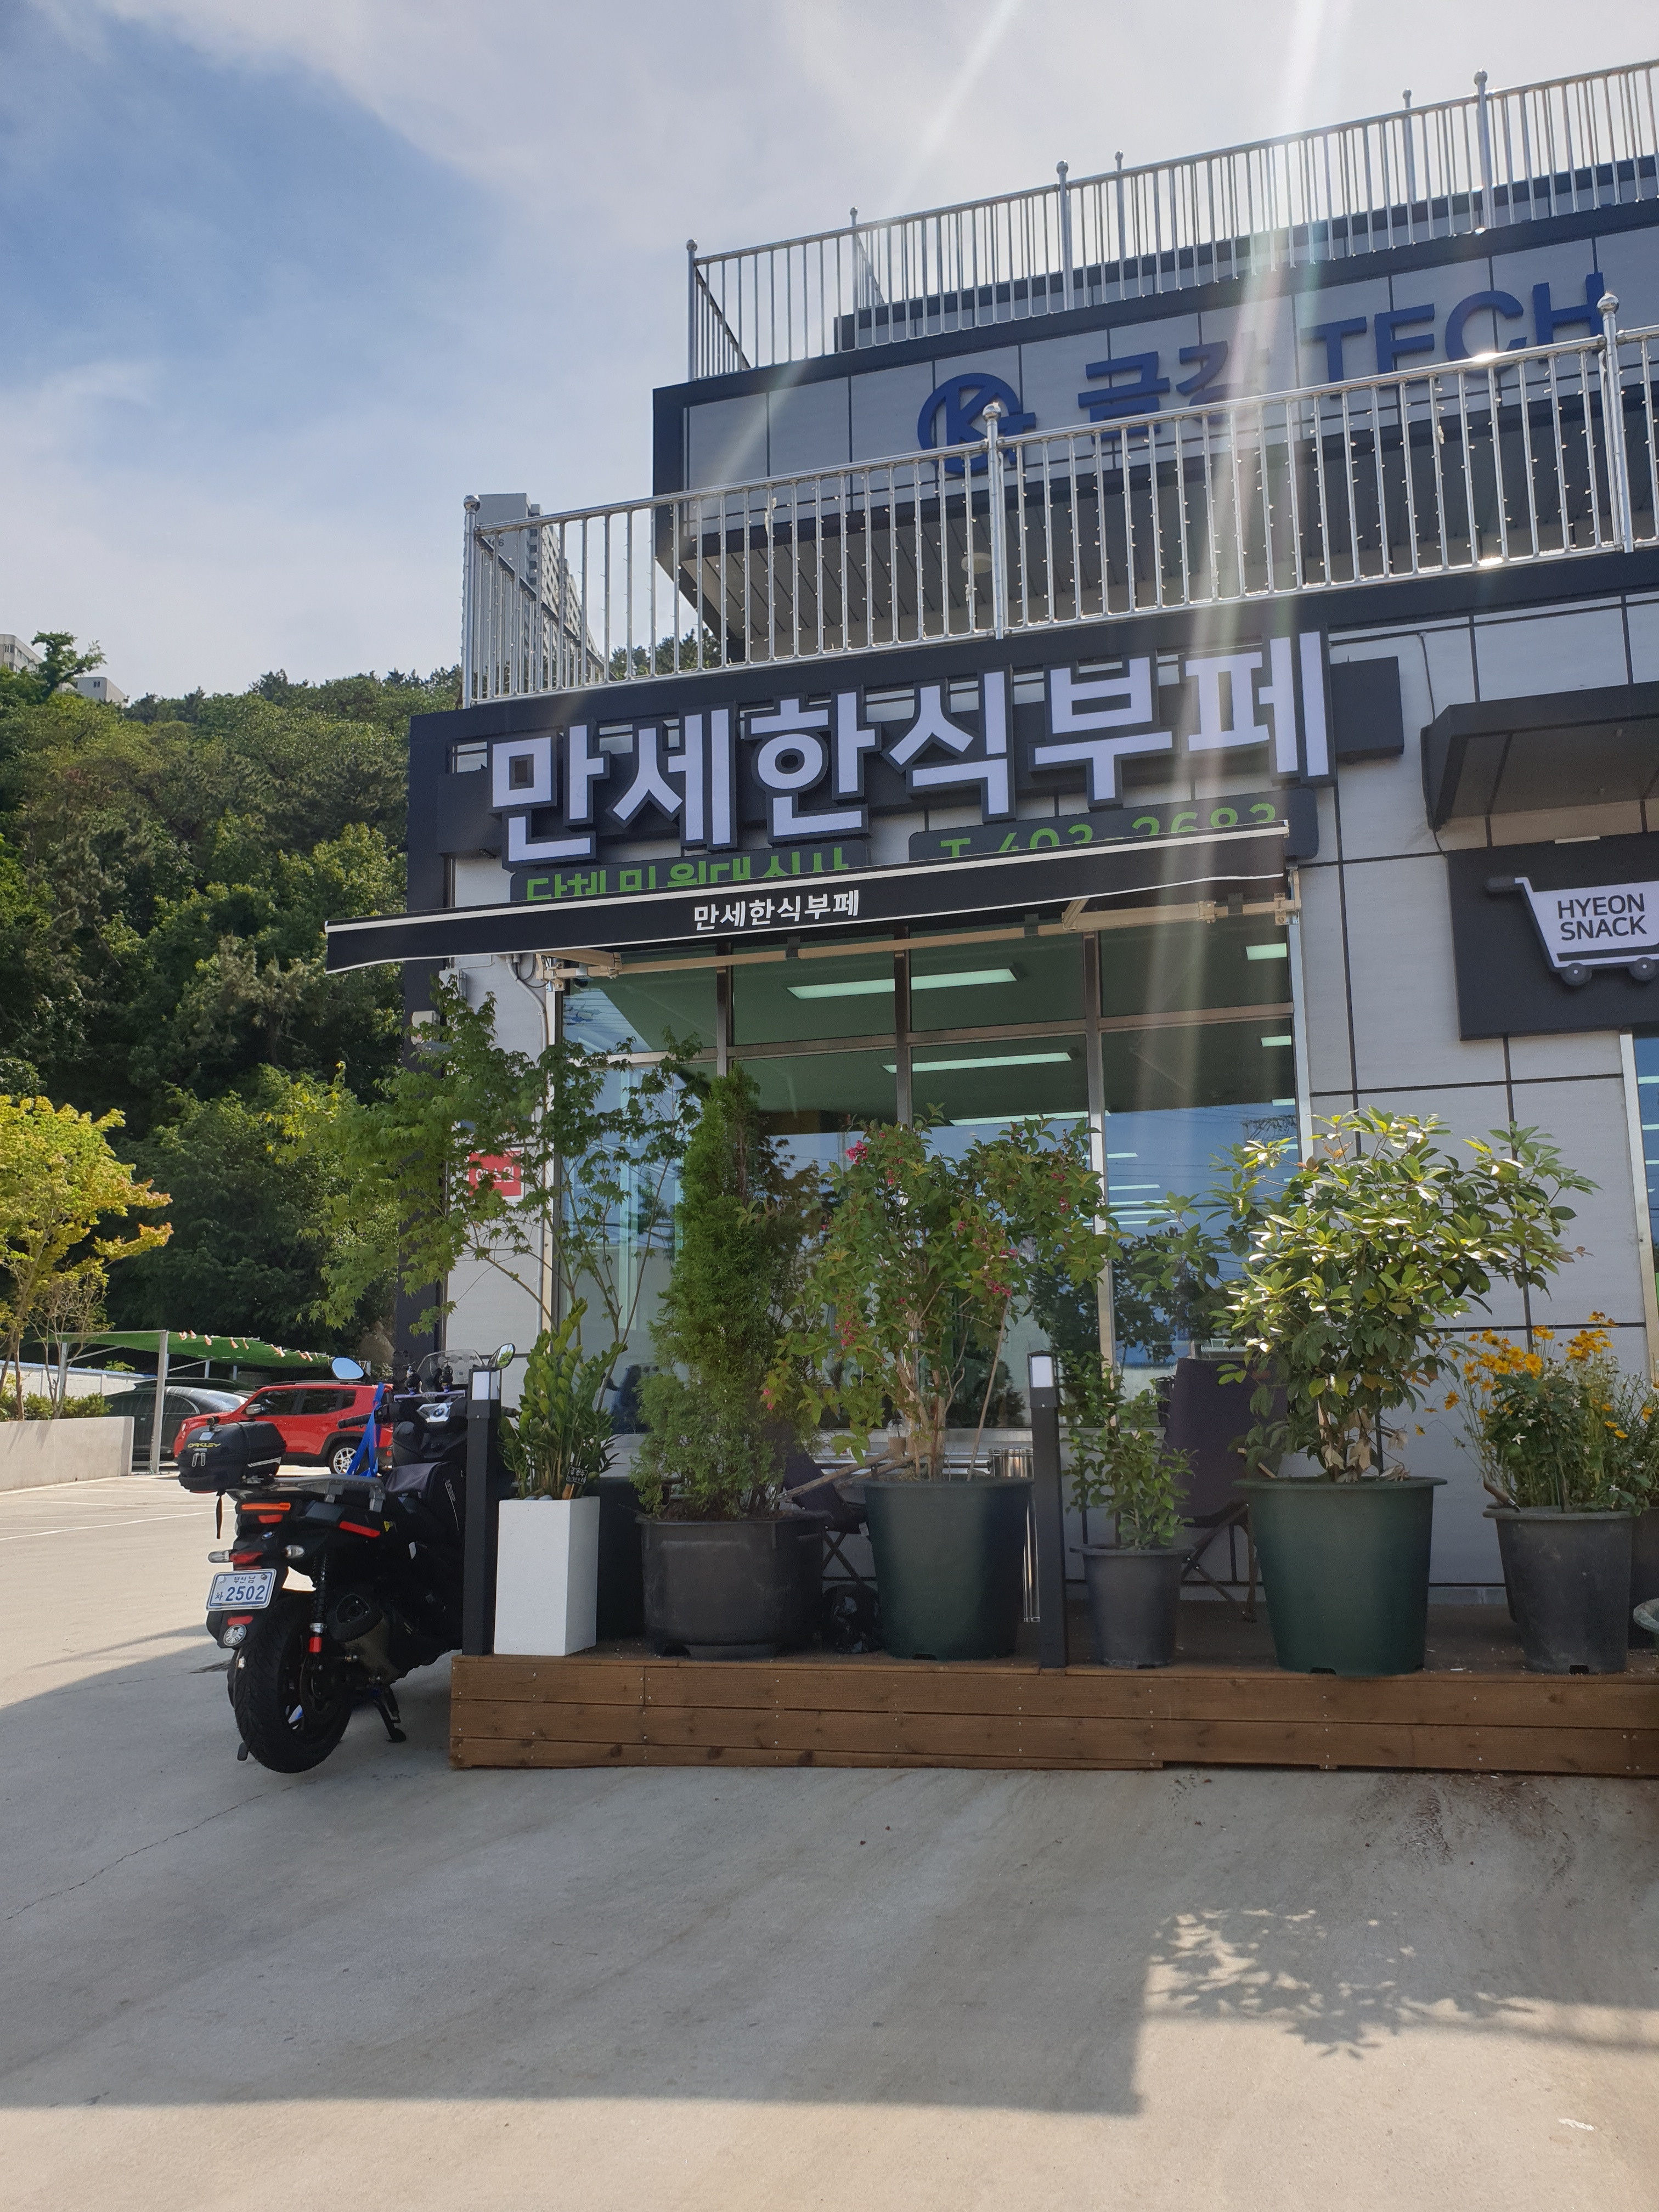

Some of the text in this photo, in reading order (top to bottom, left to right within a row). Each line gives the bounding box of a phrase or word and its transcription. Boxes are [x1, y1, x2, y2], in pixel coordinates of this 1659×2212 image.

[1299, 272, 1605, 400] TECH
[490, 630, 1330, 862] 만세한식부페
[693, 889, 859, 931] 만세한식부페
[1557, 893, 1645, 919] HYEON
[1560, 915, 1647, 941] SNACK
[225, 1585, 266, 1601] 2502
